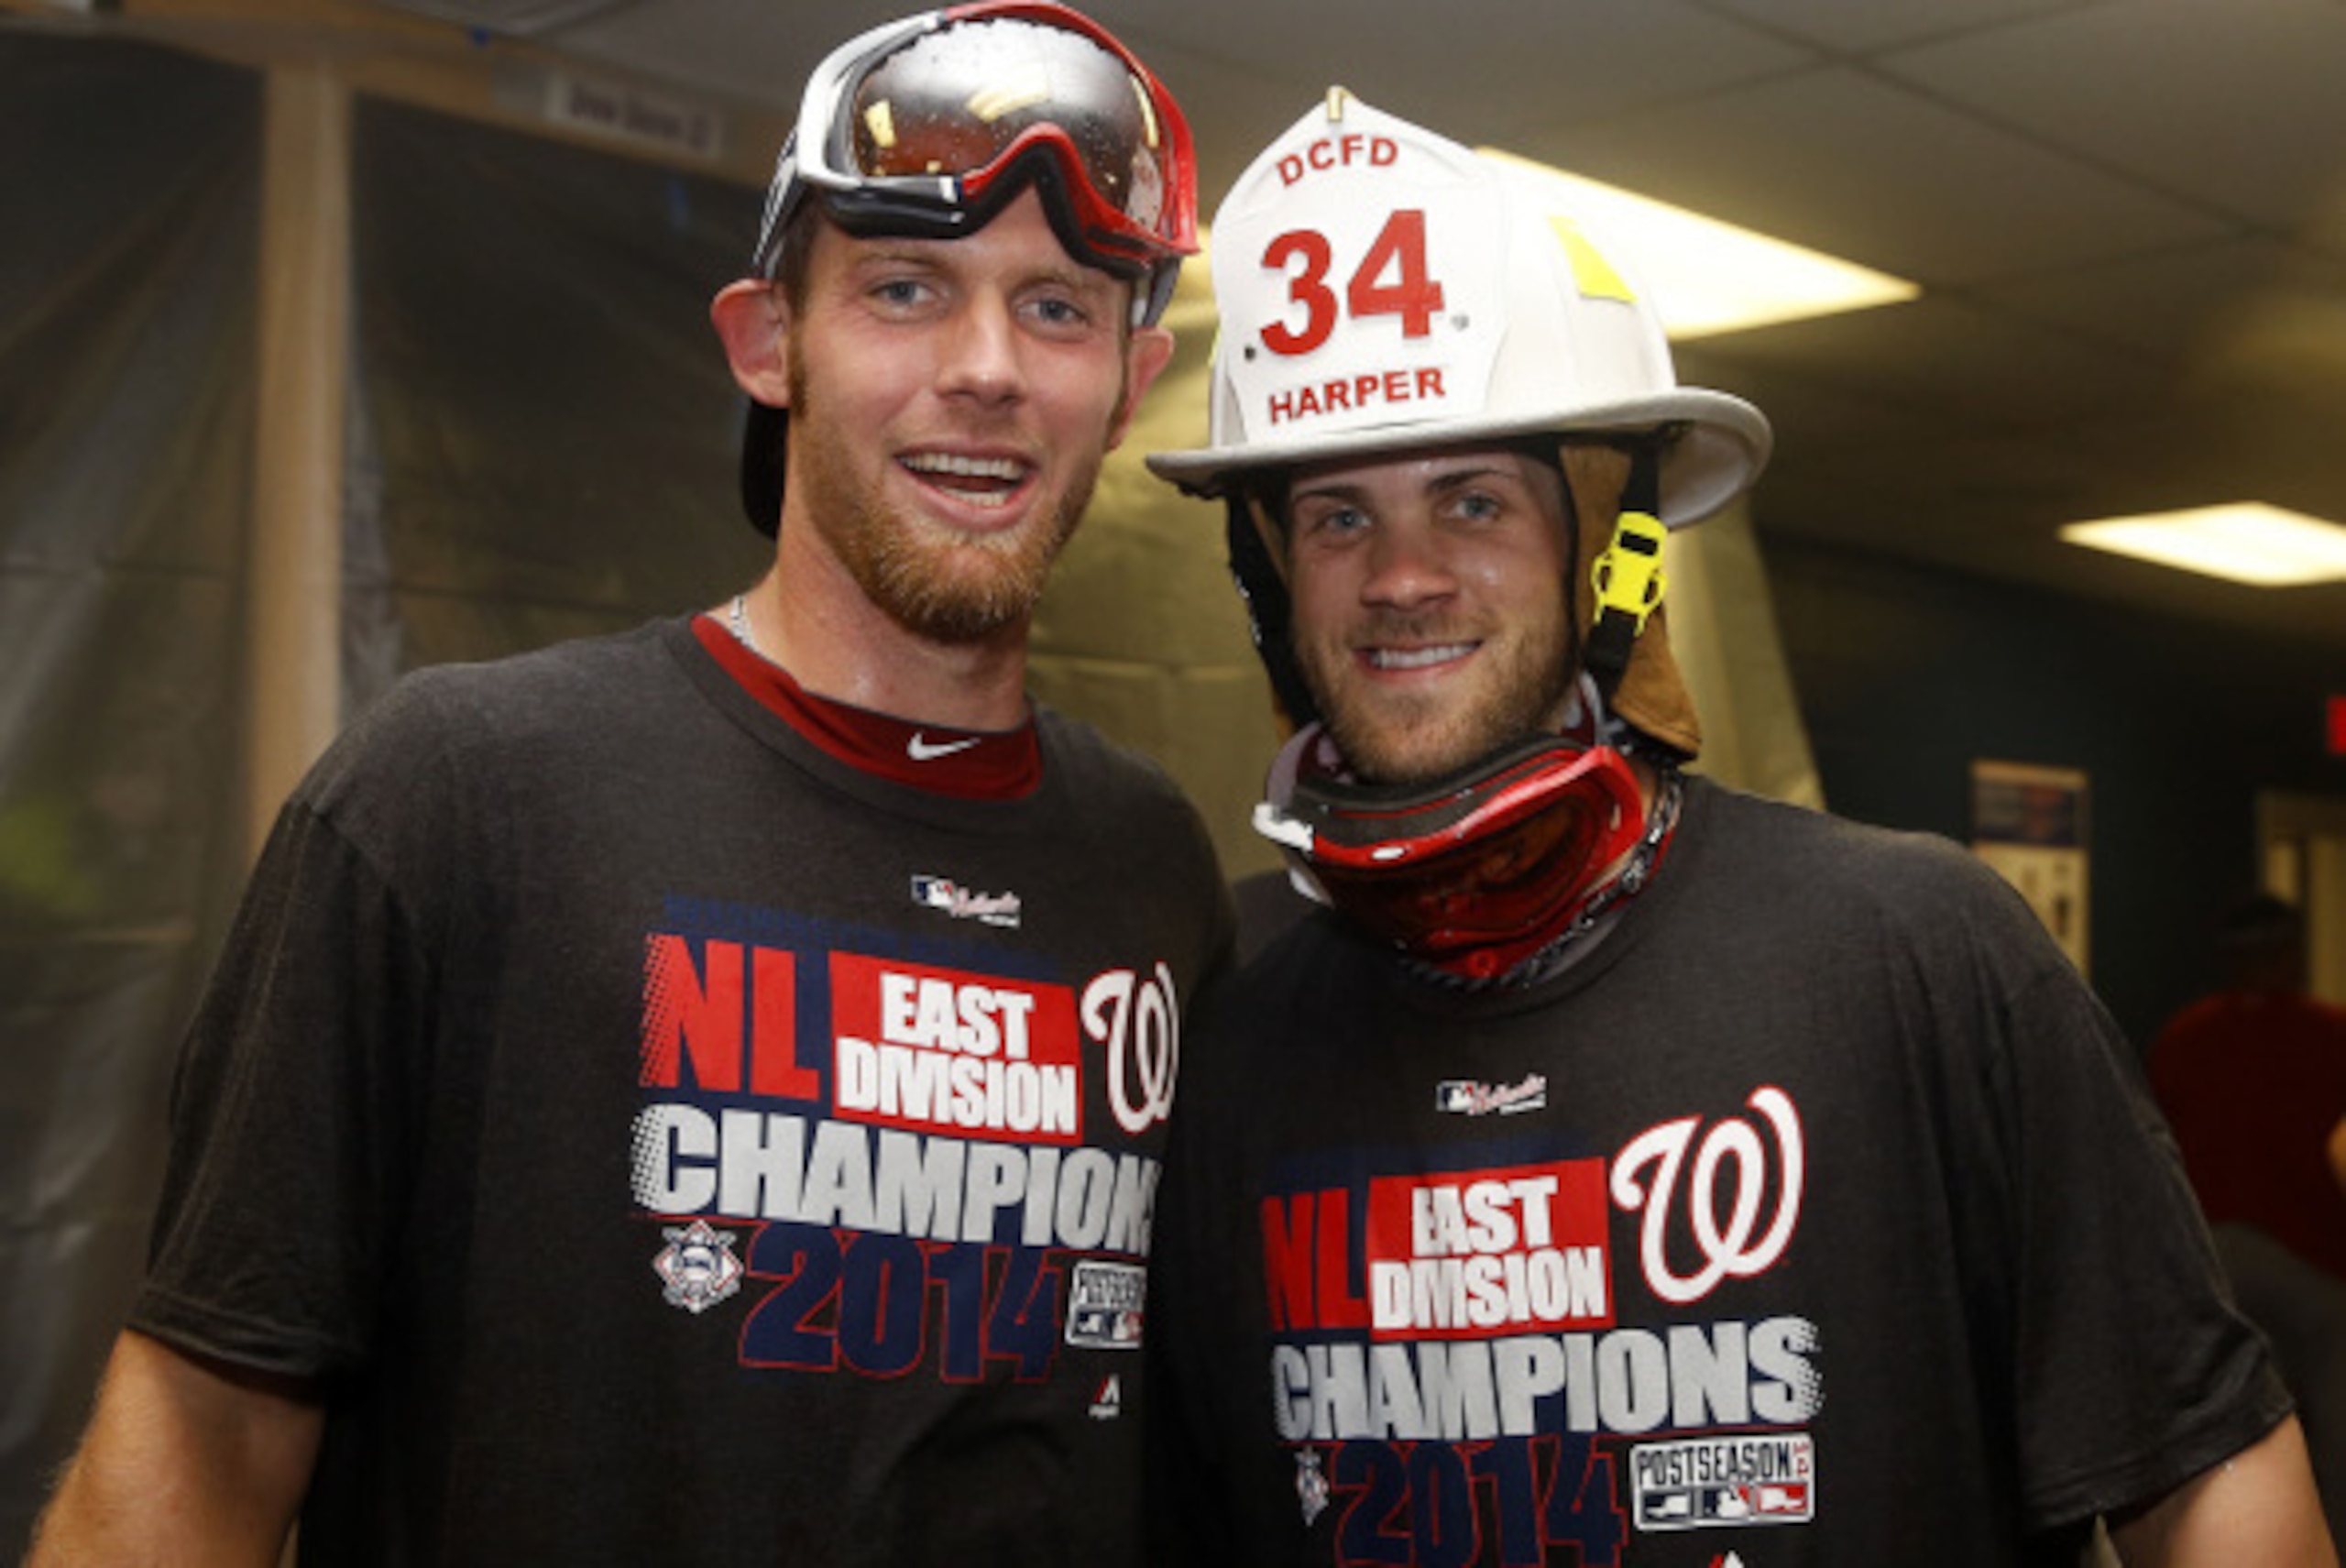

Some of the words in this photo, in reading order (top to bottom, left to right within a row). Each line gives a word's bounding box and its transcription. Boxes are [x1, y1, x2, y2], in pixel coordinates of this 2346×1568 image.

[1277, 135, 1398, 186] DCFD
[1260, 209, 1445, 356] 34
[1268, 367, 1446, 425] HARPER
[640, 933, 820, 1101] NL
[881, 970, 1035, 1059] EAST
[837, 1036, 1078, 1135] DIVISION
[1411, 1176, 1558, 1258] EAST
[1610, 1084, 1805, 1305] W
[739, 1220, 1064, 1383] 2014
[1261, 1188, 1370, 1332] NL
[1372, 1246, 1606, 1331] DIVISION
[1272, 1315, 1825, 1442] CHAMPIONS
[1331, 1436, 1629, 1568] 2014
[1636, 1442, 1791, 1486] POSTSEASON
